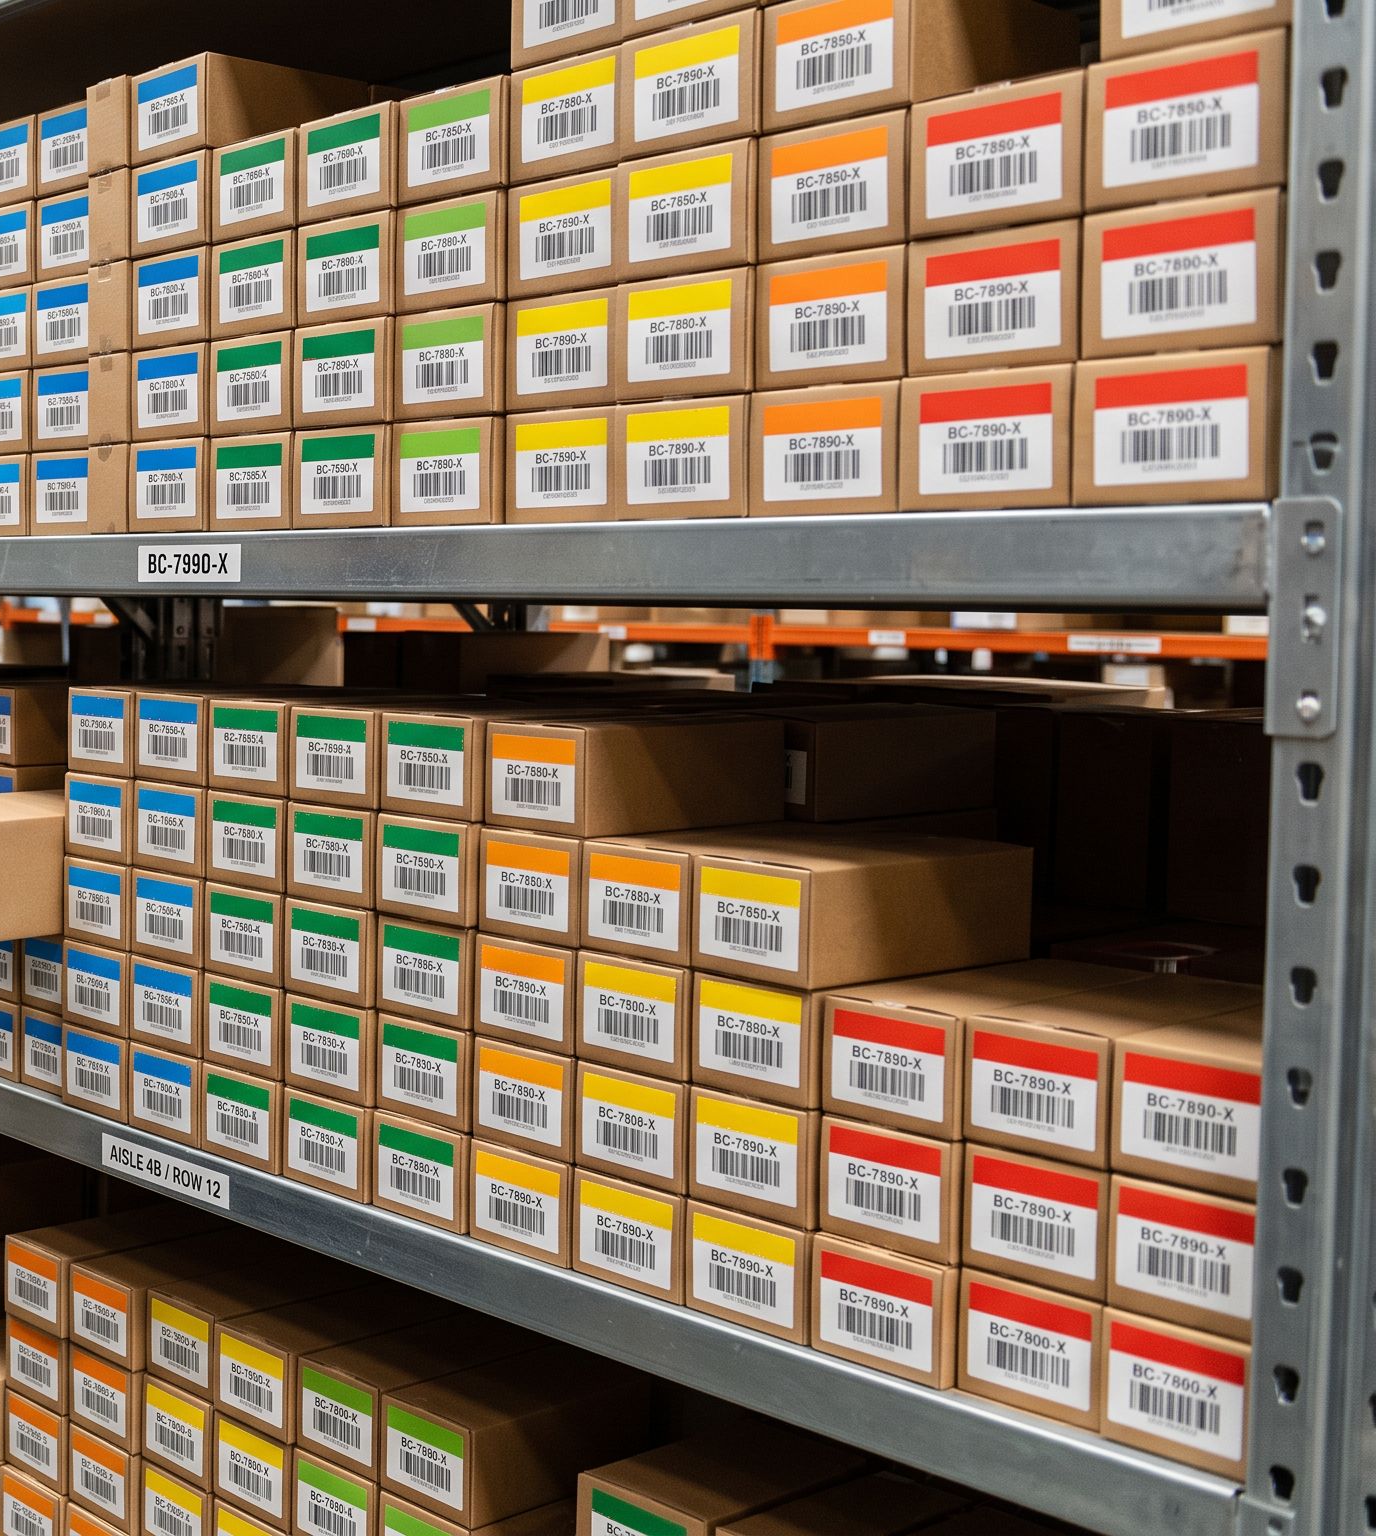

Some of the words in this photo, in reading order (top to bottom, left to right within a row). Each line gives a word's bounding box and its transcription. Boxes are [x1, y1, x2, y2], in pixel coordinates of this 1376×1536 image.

[801, 30, 866, 56] BC-7850-X
[426, 123, 471, 142] BC-7850-X
[797, 167, 860, 190] BC-7850-X
[651, 192, 707, 211] BC-7850-X
[954, 281, 1028, 301] BC-7890-X
[536, 333, 587, 349] BC-7890-X
[318, 359, 358, 370] BC-7890-X
[1128, 407, 1211, 426] BC-7890-X
[948, 422, 1021, 439] BC-7890-X
[649, 442, 705, 456] BC-7890-X
[789, 435, 854, 450] BC-7890-X
[317, 462, 357, 474] BC-7590-X
[417, 458, 462, 471] BC-7890-X
[536, 451, 586, 464] BC-7590-X
[148, 553, 228, 574] BC-7990-X
[397, 854, 444, 869] BC-7590-X
[495, 976, 546, 996] BC-7890-X
[303, 1031, 346, 1050] BC-7830-X
[396, 1053, 441, 1073] BC-7830-X
[852, 1045, 922, 1070] BC-7890-X
[994, 1069, 1071, 1095] BC-7890-X
[1147, 1093, 1234, 1121] BC-7890-X
[599, 1106, 655, 1130] BC-7808-X
[714, 1132, 777, 1157] BC-7890-X
[110, 1145, 143, 1171] AISLE
[146, 1158, 162, 1176] 4B
[164, 1164, 169, 1180] /
[173, 1166, 202, 1191] ROW
[206, 1179, 220, 1198] 12
[848, 1163, 918, 1189] BC-7890-X
[491, 1184, 542, 1207] BC-7890-X
[994, 1195, 1071, 1222] BC-7890-X
[597, 1215, 653, 1241] BC-7890-X
[1141, 1227, 1226, 1257] BC-7890-X
[711, 1250, 773, 1277] BC-7890-X
[840, 1288, 908, 1318] BC-7890-X
[990, 1322, 1066, 1353] BC-7800-X
